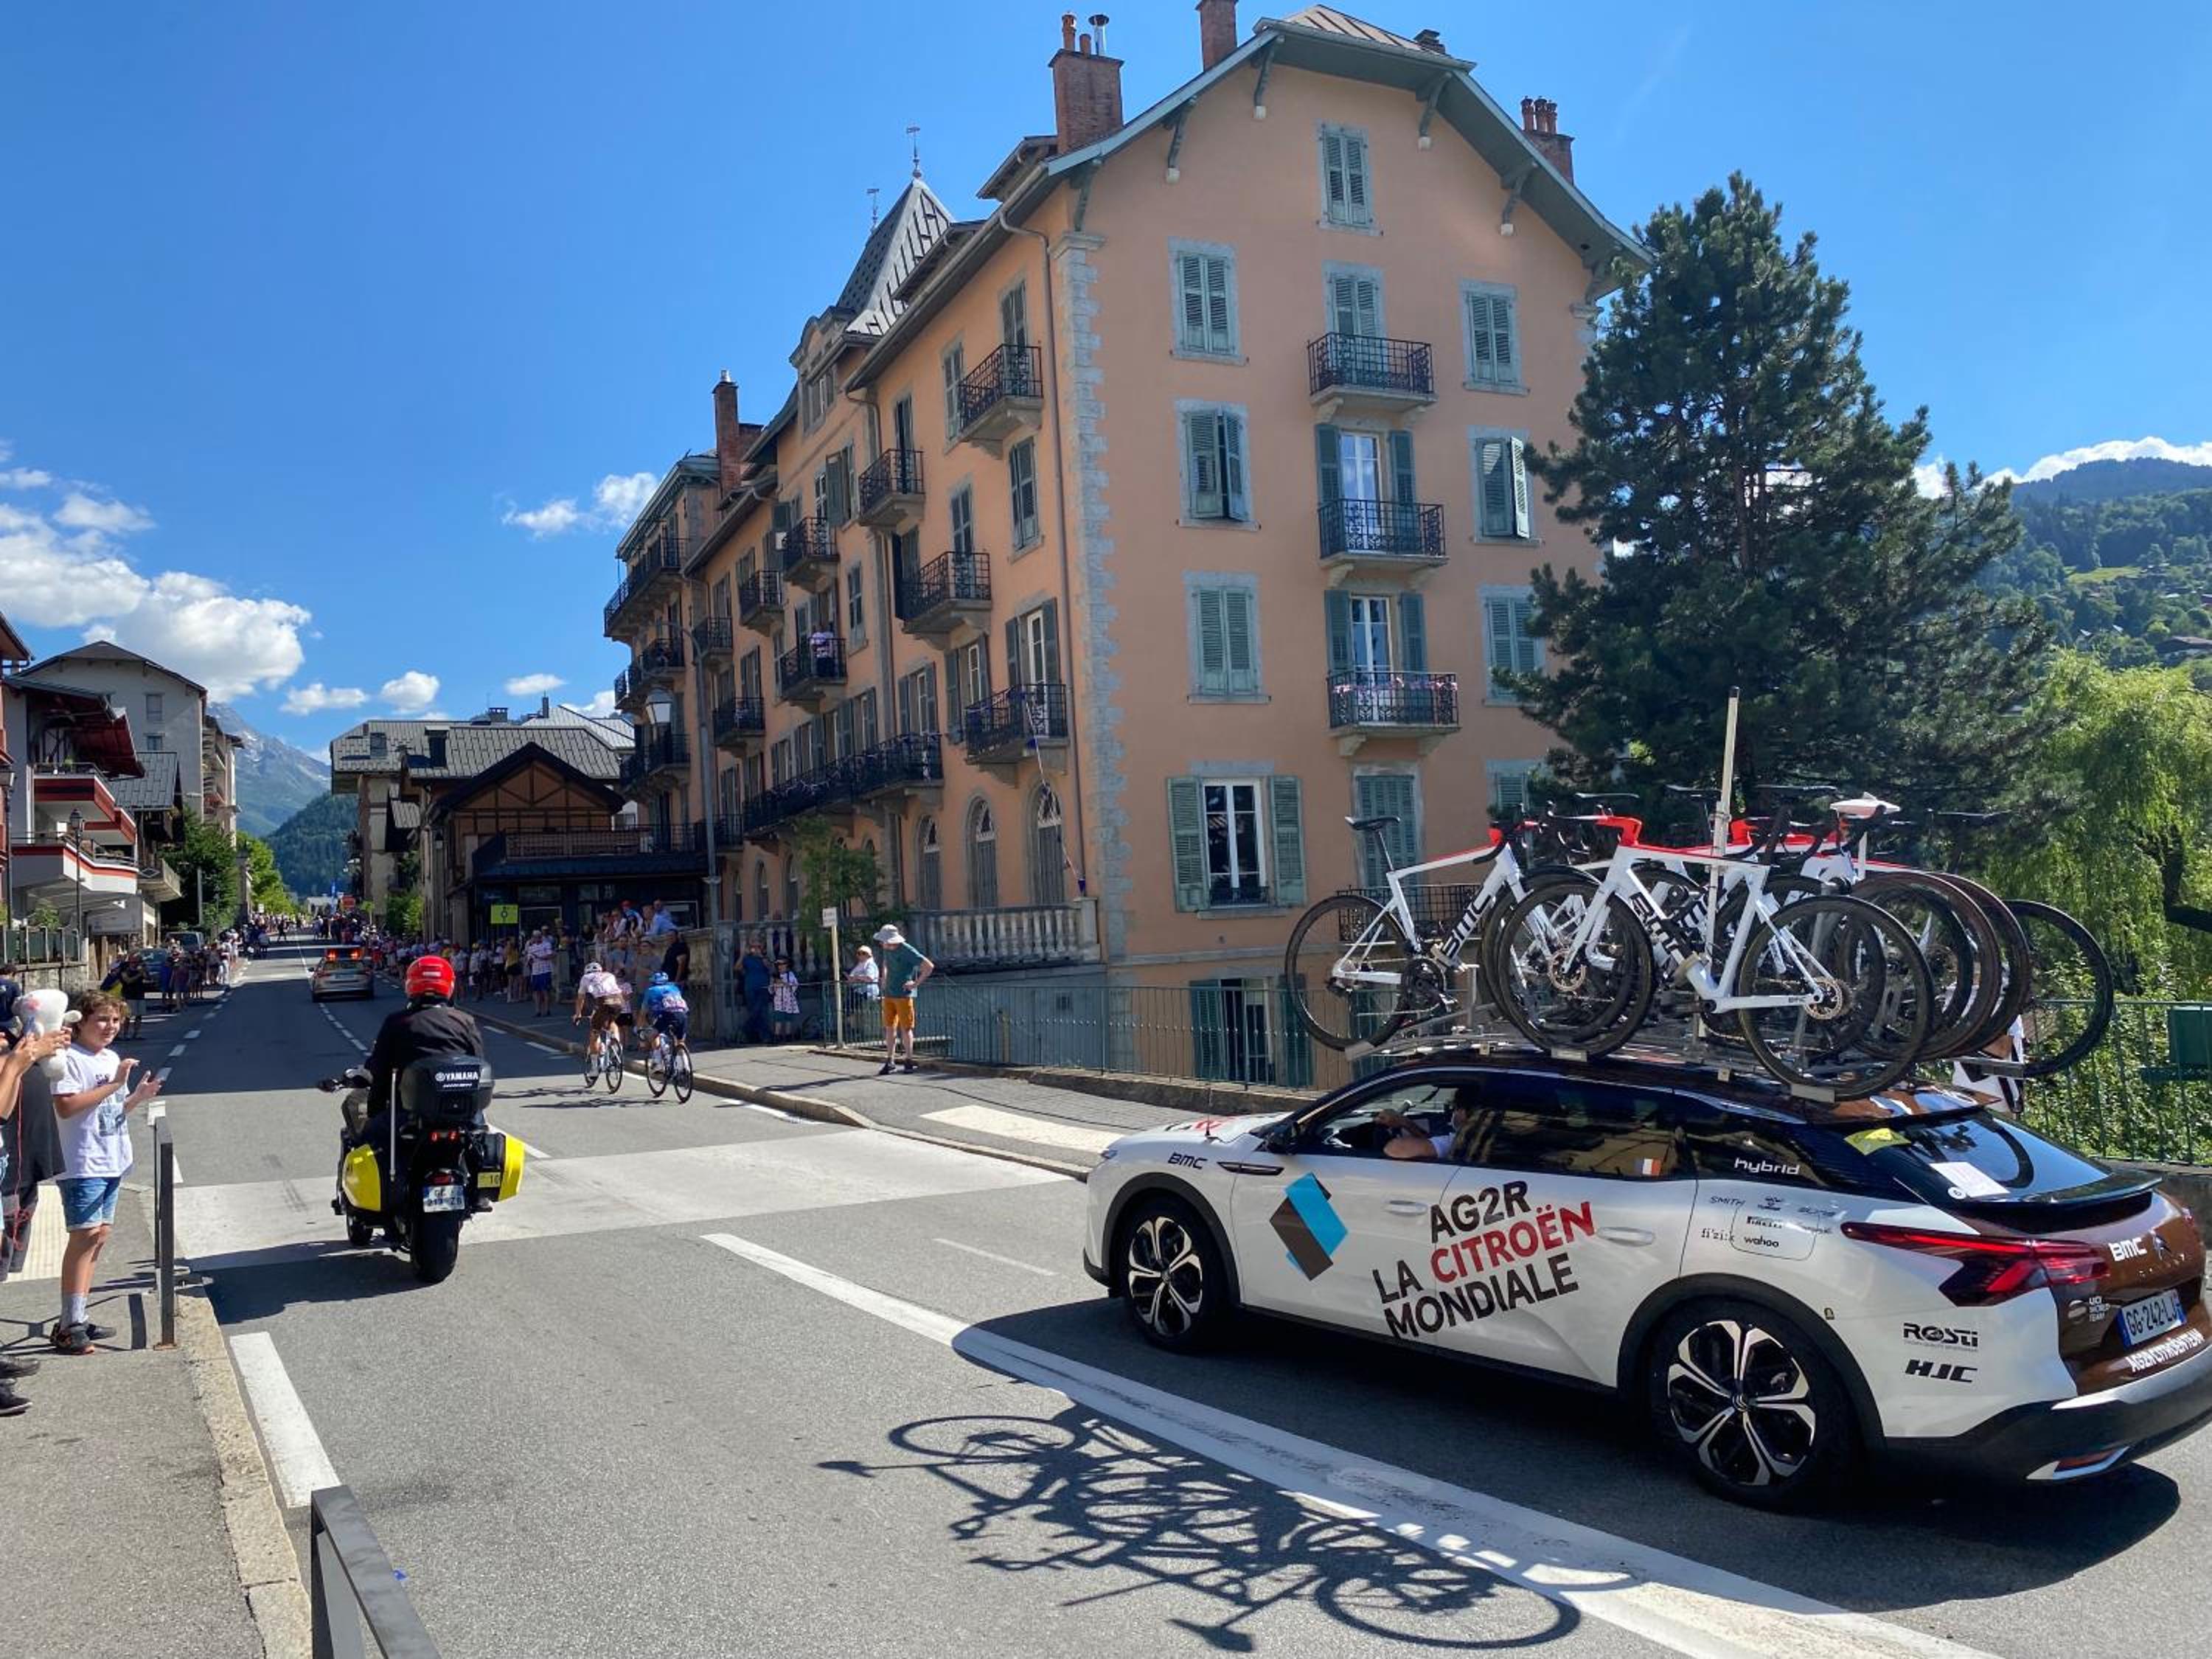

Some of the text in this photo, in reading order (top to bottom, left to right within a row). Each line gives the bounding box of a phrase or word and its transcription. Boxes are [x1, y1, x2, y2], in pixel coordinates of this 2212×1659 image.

[445, 1071, 479, 1081] YAMAHA
[1168, 1152, 1208, 1169] BMC
[1734, 1158, 1800, 1175] hybrid
[1709, 1195, 1746, 1207] SMITH
[1430, 1180, 1531, 1244] AG2R
[1744, 1235, 1780, 1248] wahoo
[2108, 1237, 2148, 1262] BMC
[1372, 1201, 1596, 1304] LA CITROËN
[1384, 1252, 1579, 1338] MONDIALE
[1905, 1358, 1978, 1383] HJC
